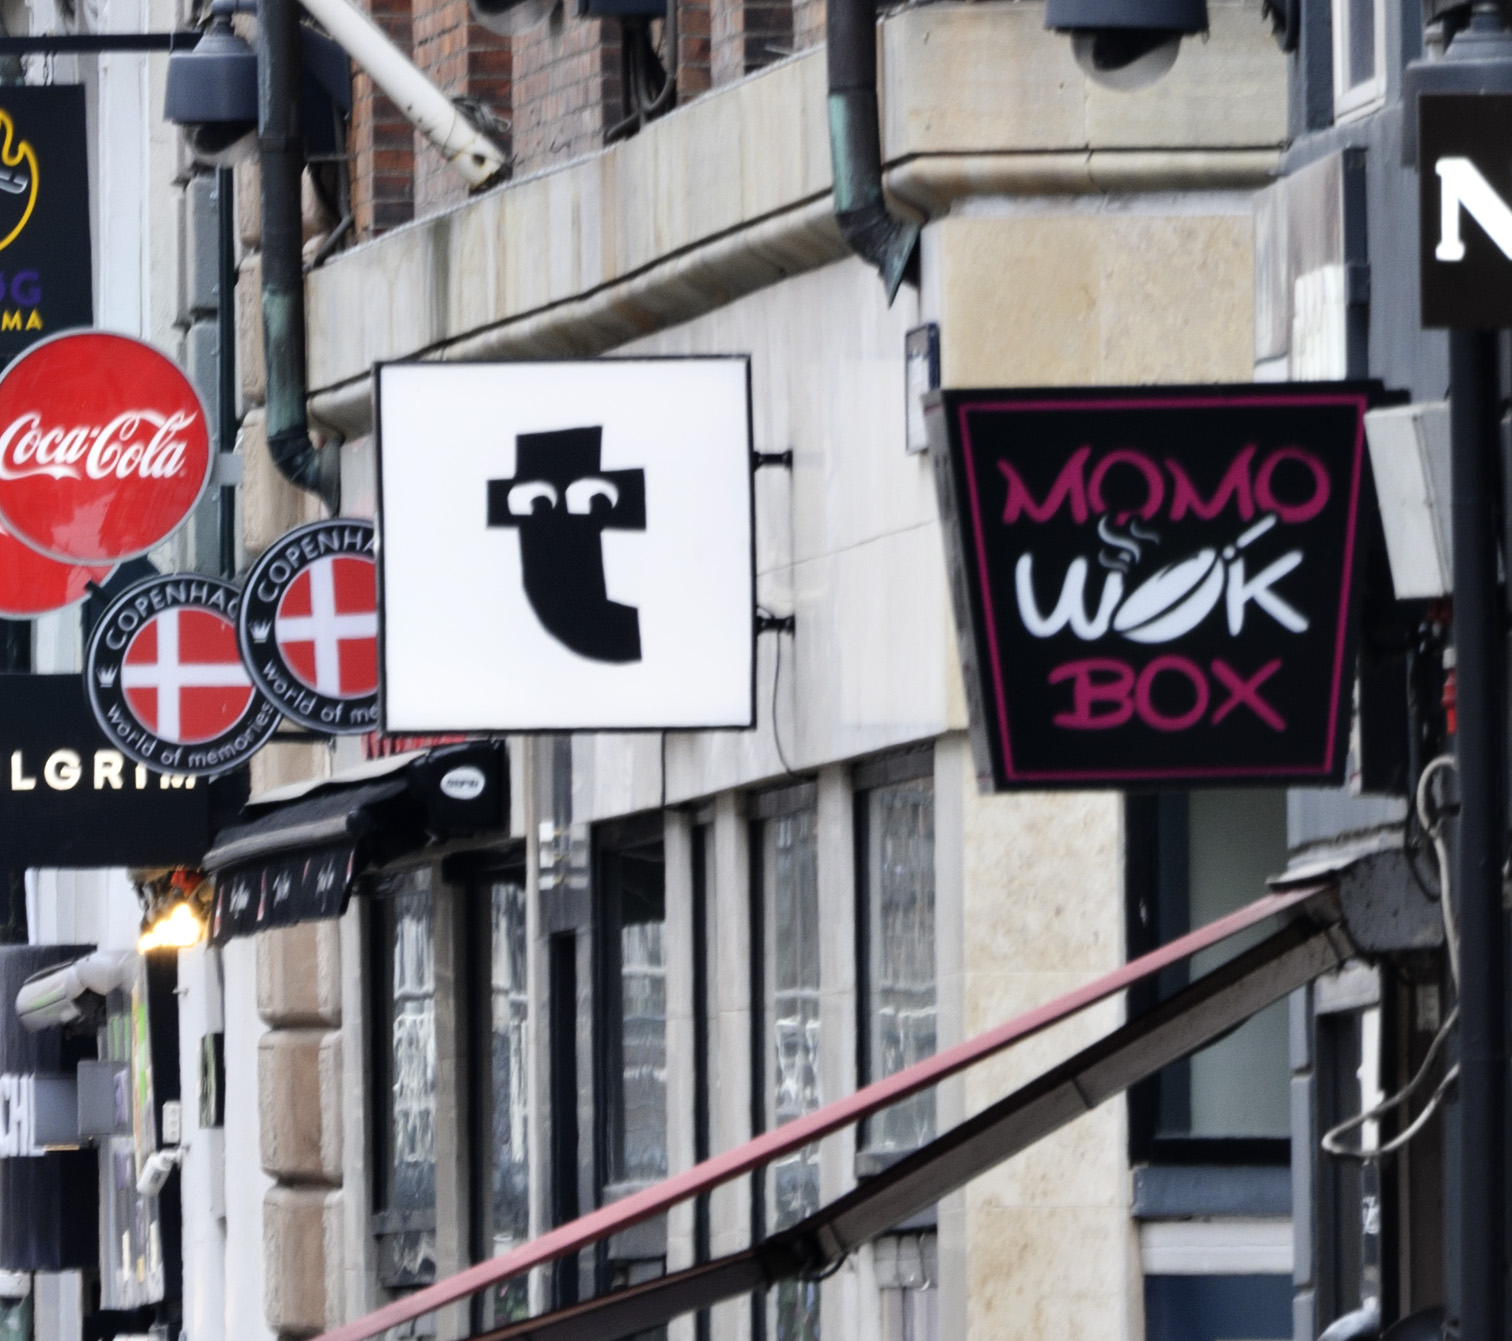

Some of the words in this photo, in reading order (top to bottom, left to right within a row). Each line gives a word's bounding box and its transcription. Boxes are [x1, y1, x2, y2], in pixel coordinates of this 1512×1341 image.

[998, 445, 1331, 526] MOMO
[1016, 545, 1310, 645] WOK
[321, 706, 342, 724] of
[1049, 655, 1286, 732] BOX
[161, 743, 180, 766] of
